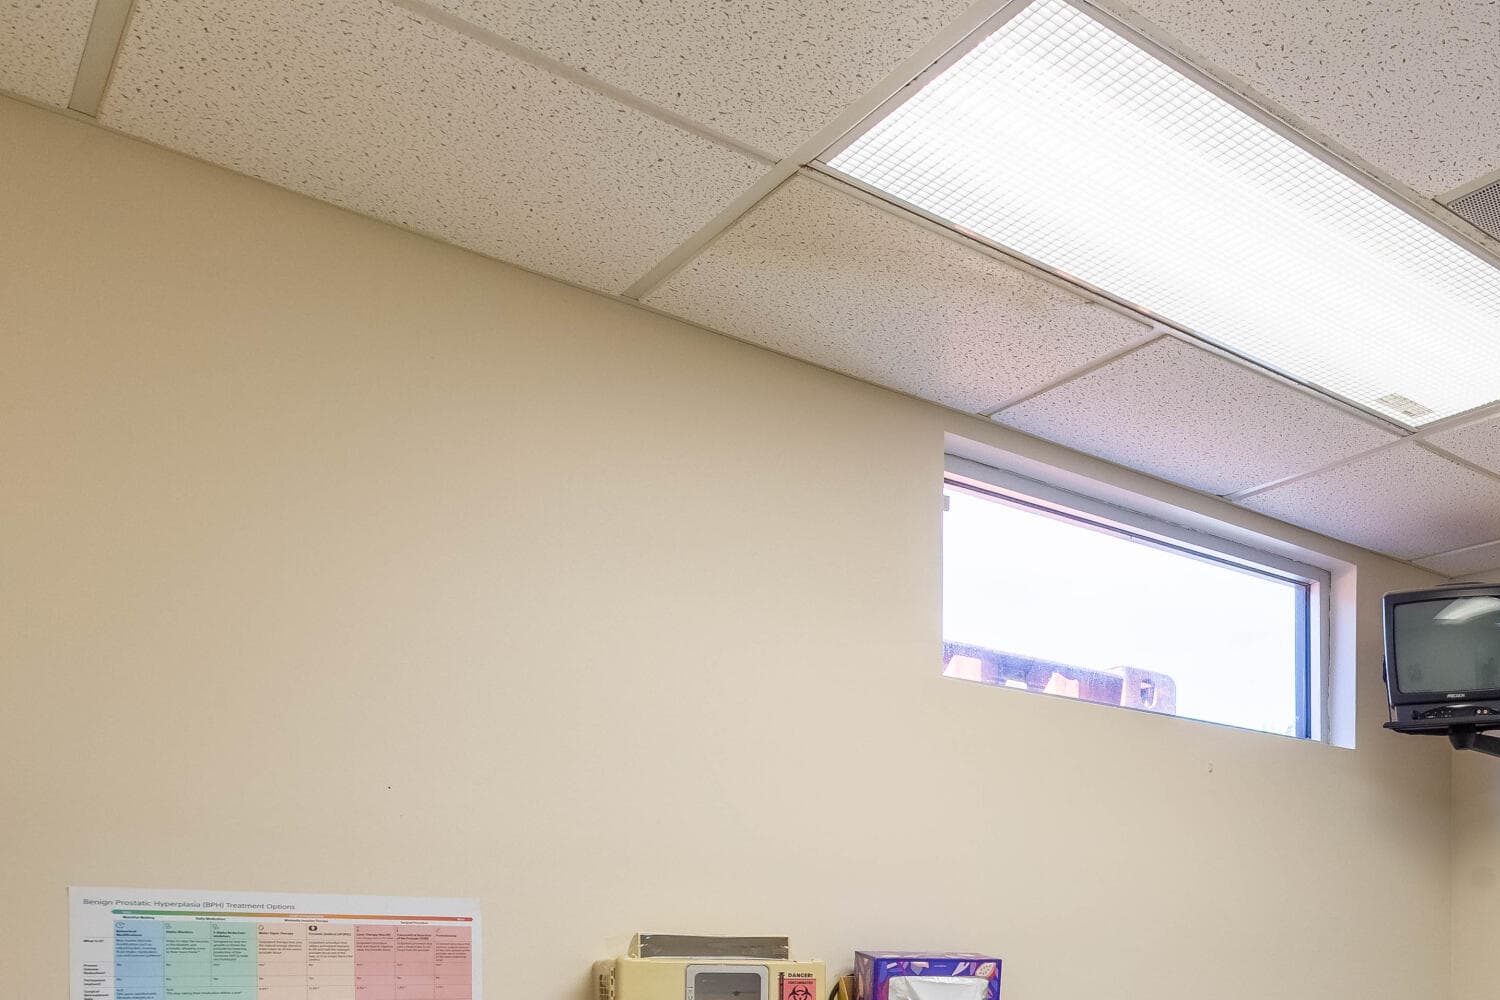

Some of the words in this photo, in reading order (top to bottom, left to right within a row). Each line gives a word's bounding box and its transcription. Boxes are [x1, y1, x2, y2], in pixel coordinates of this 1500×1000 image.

[82, 898, 114, 907] Benign
[115, 899, 152, 908] Prostatic
[153, 901, 201, 911] Hyperplasia
[202, 902, 225, 910] (BPH)
[226, 902, 265, 911] Treatment
[266, 904, 296, 912] Options
